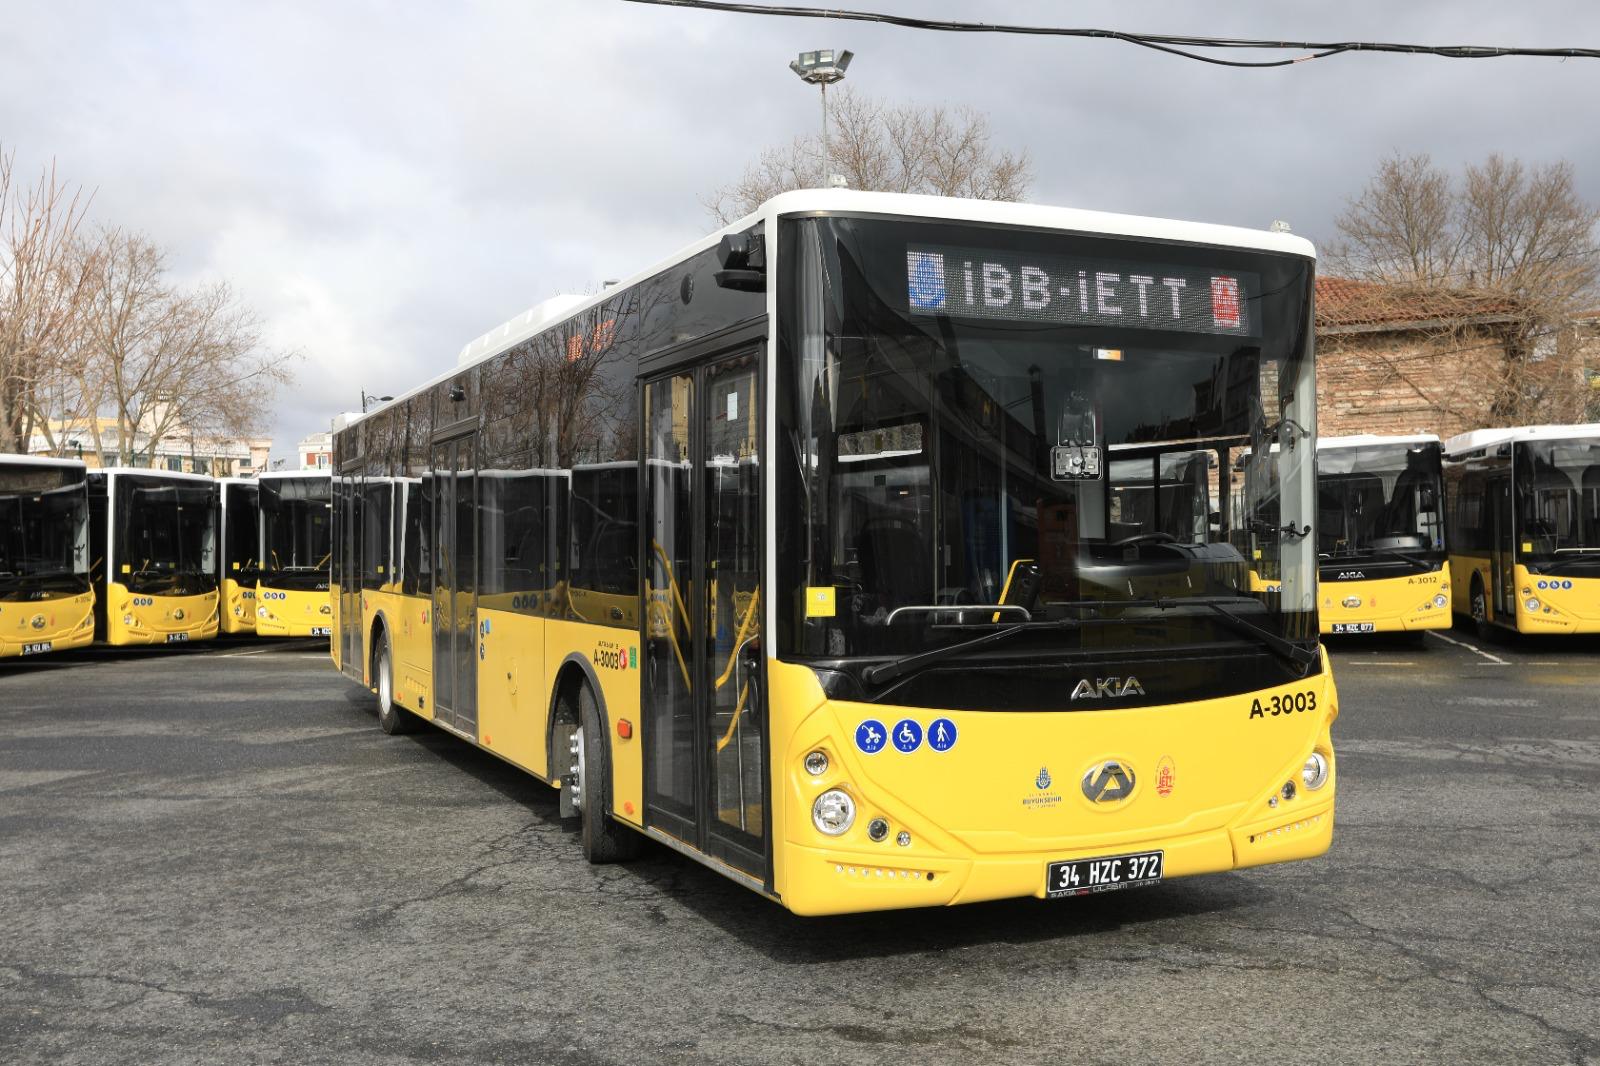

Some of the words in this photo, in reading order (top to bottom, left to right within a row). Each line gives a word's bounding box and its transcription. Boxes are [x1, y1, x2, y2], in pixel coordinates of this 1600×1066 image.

[1337, 571, 1366, 580] AKIA
[1407, 576, 1438, 586] A-3012
[594, 649, 618, 670] A-3003
[1071, 676, 1146, 701] AKIA
[1249, 691, 1317, 719] A-3003
[1059, 865, 1080, 888] 34
[1089, 860, 1122, 885] HZC
[1128, 855, 1158, 880] 372
